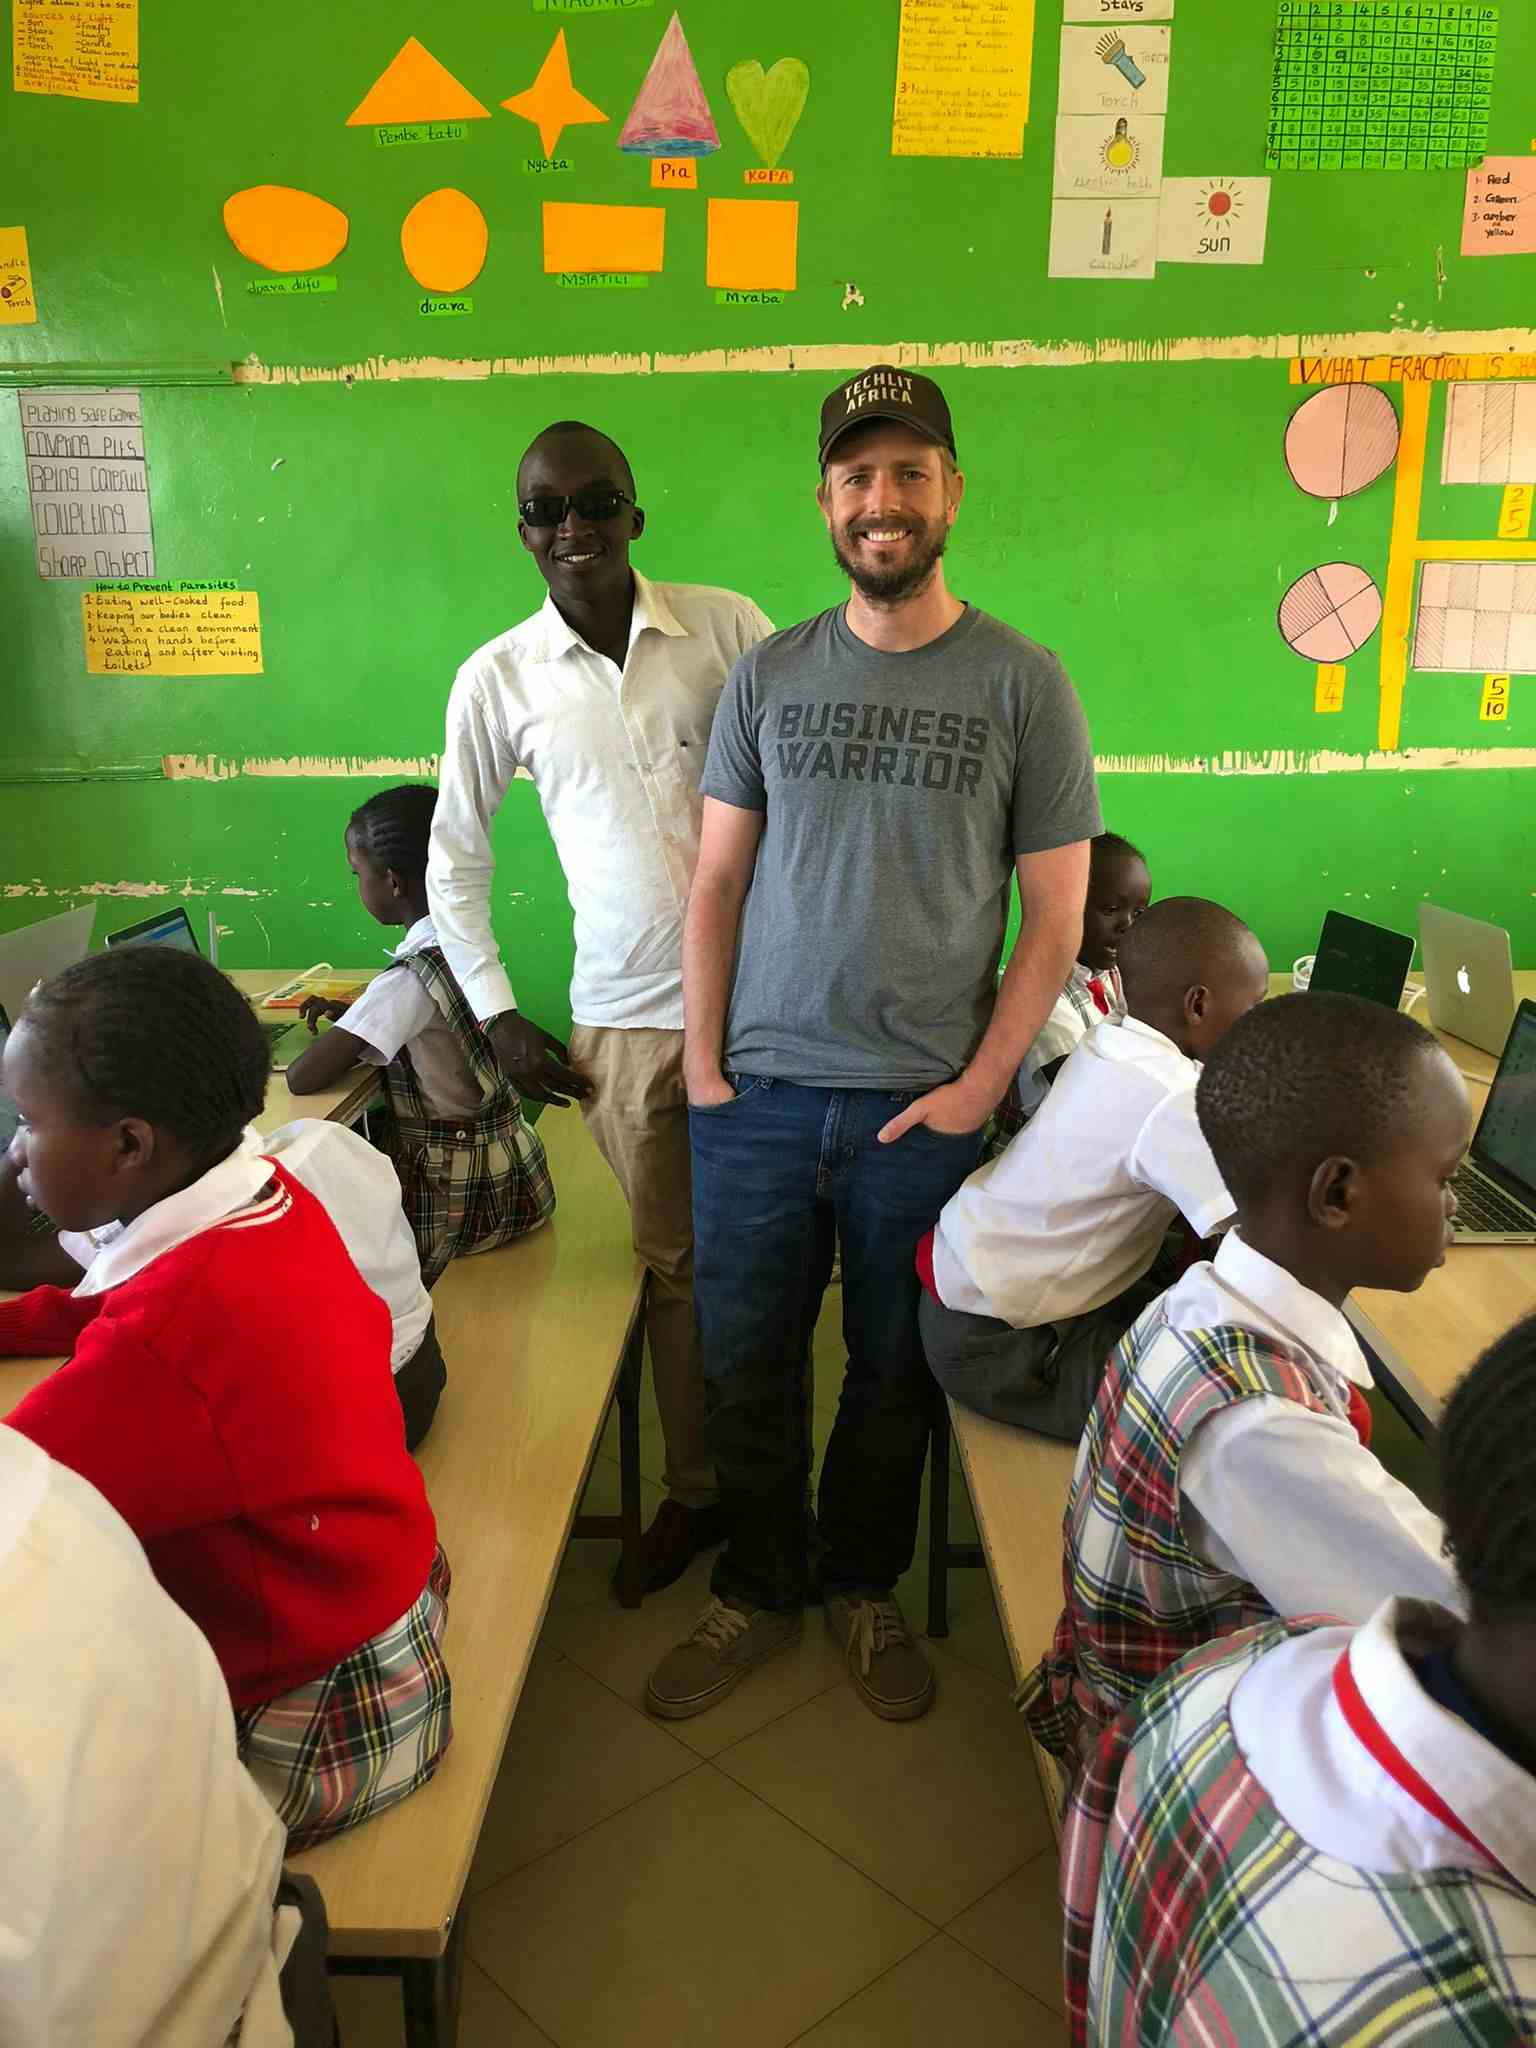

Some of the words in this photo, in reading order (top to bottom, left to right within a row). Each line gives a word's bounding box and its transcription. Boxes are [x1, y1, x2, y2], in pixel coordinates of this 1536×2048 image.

[1280, 3, 1289, 12] 0
[1313, 5, 1320, 14] 2
[1335, 4, 1343, 14] 3
[1360, 5, 1370, 15] 4
[1381, 6, 1389, 15] 5
[1405, 6, 1413, 16] 6
[1425, 8, 1433, 16] 7
[1447, 8, 1454, 16] 8
[1464, 8, 1472, 17] 9
[1482, 10, 1493, 18] 10
[1313, 33, 1321, 44] 4
[379, 130, 419, 144] Pembe
[428, 126, 462, 141] tatu
[527, 159, 568, 173] Nyota
[1487, 172, 1511, 185] Red
[726, 292, 781, 304] Mraba
[420, 299, 468, 314] duara
[1301, 357, 1374, 384] WHAT
[1389, 354, 1469, 382] FRACTION
[844, 372, 912, 400] TECHLIT
[846, 387, 912, 414] AFRICA
[1508, 487, 1524, 503] 2
[1506, 508, 1523, 533] 5
[132, 581, 173, 592] Prevent
[159, 611, 191, 619] bodies
[158, 624, 189, 633] clean
[158, 634, 192, 645] hands
[200, 633, 236, 649] before
[158, 647, 176, 657] and
[182, 647, 214, 662] after
[1490, 677, 1507, 696] 5
[1485, 701, 1505, 717] 10
[777, 702, 990, 755] BUSINESS
[776, 741, 984, 798] WARRIOR
